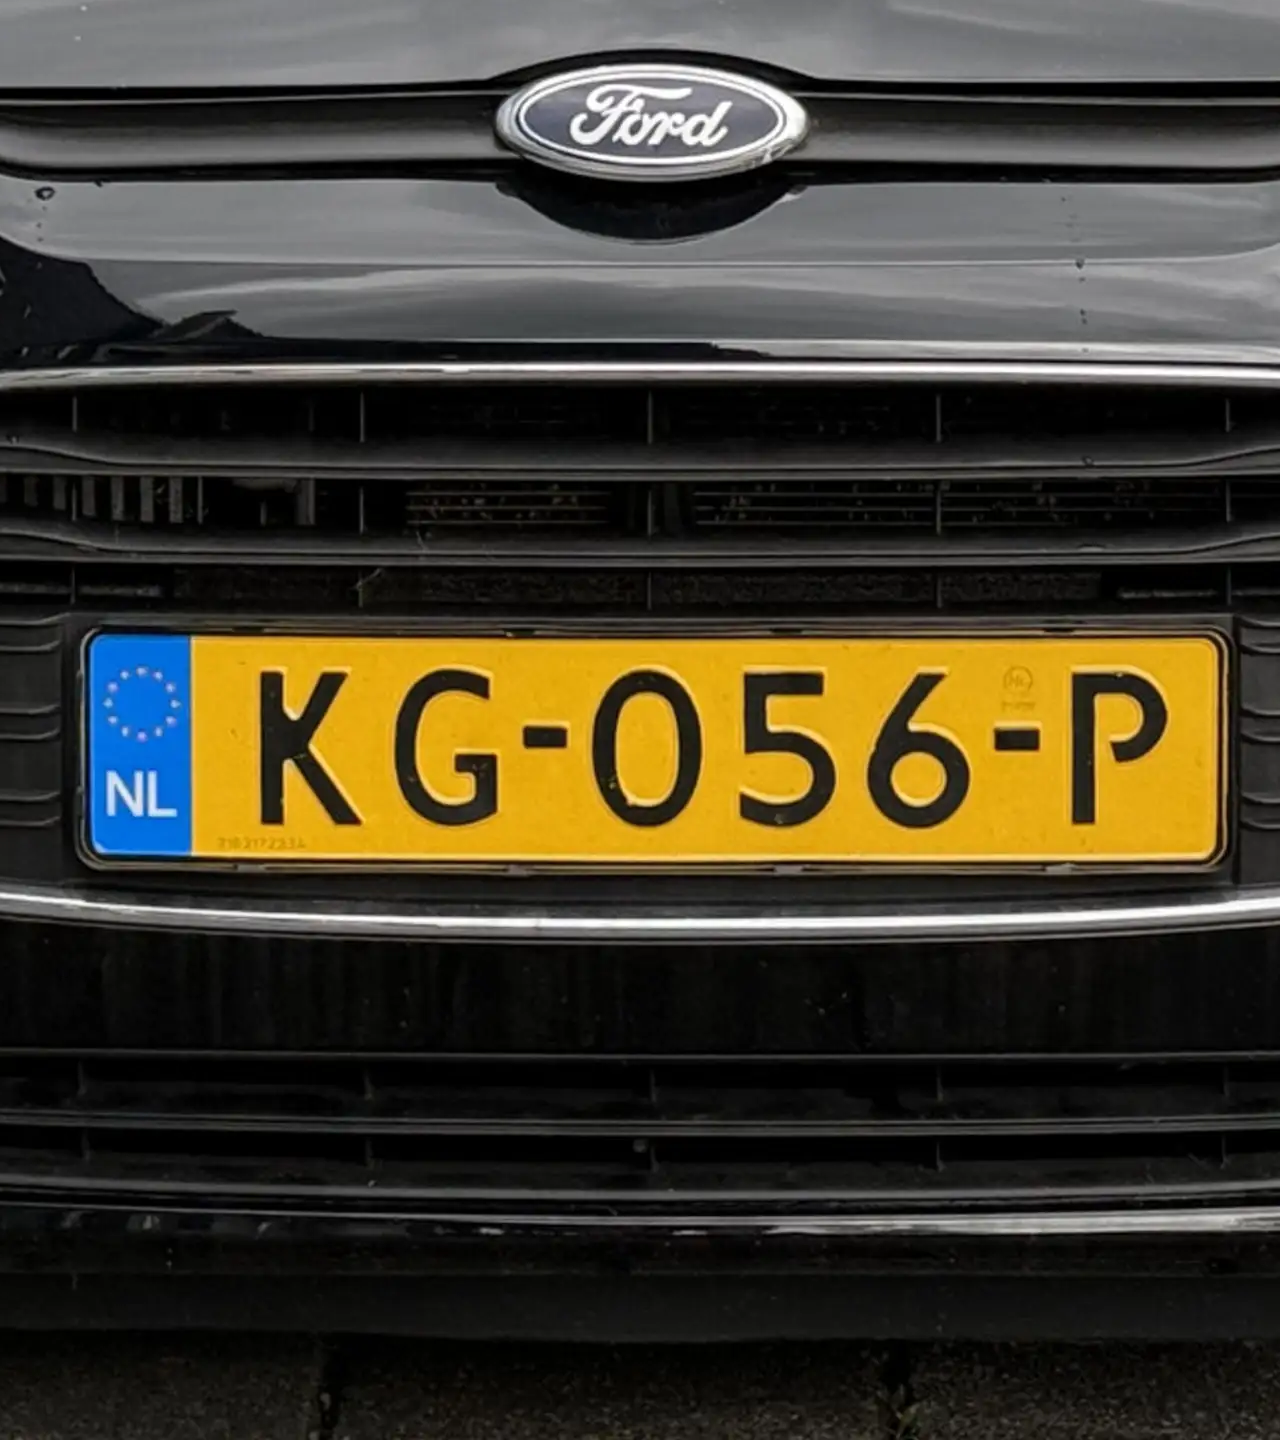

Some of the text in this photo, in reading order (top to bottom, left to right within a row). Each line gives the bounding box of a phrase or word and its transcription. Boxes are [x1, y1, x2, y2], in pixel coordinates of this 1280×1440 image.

[570, 83, 733, 147] Ford
[258, 668, 1167, 828] KG-056-P
[106, 770, 178, 817] NL
